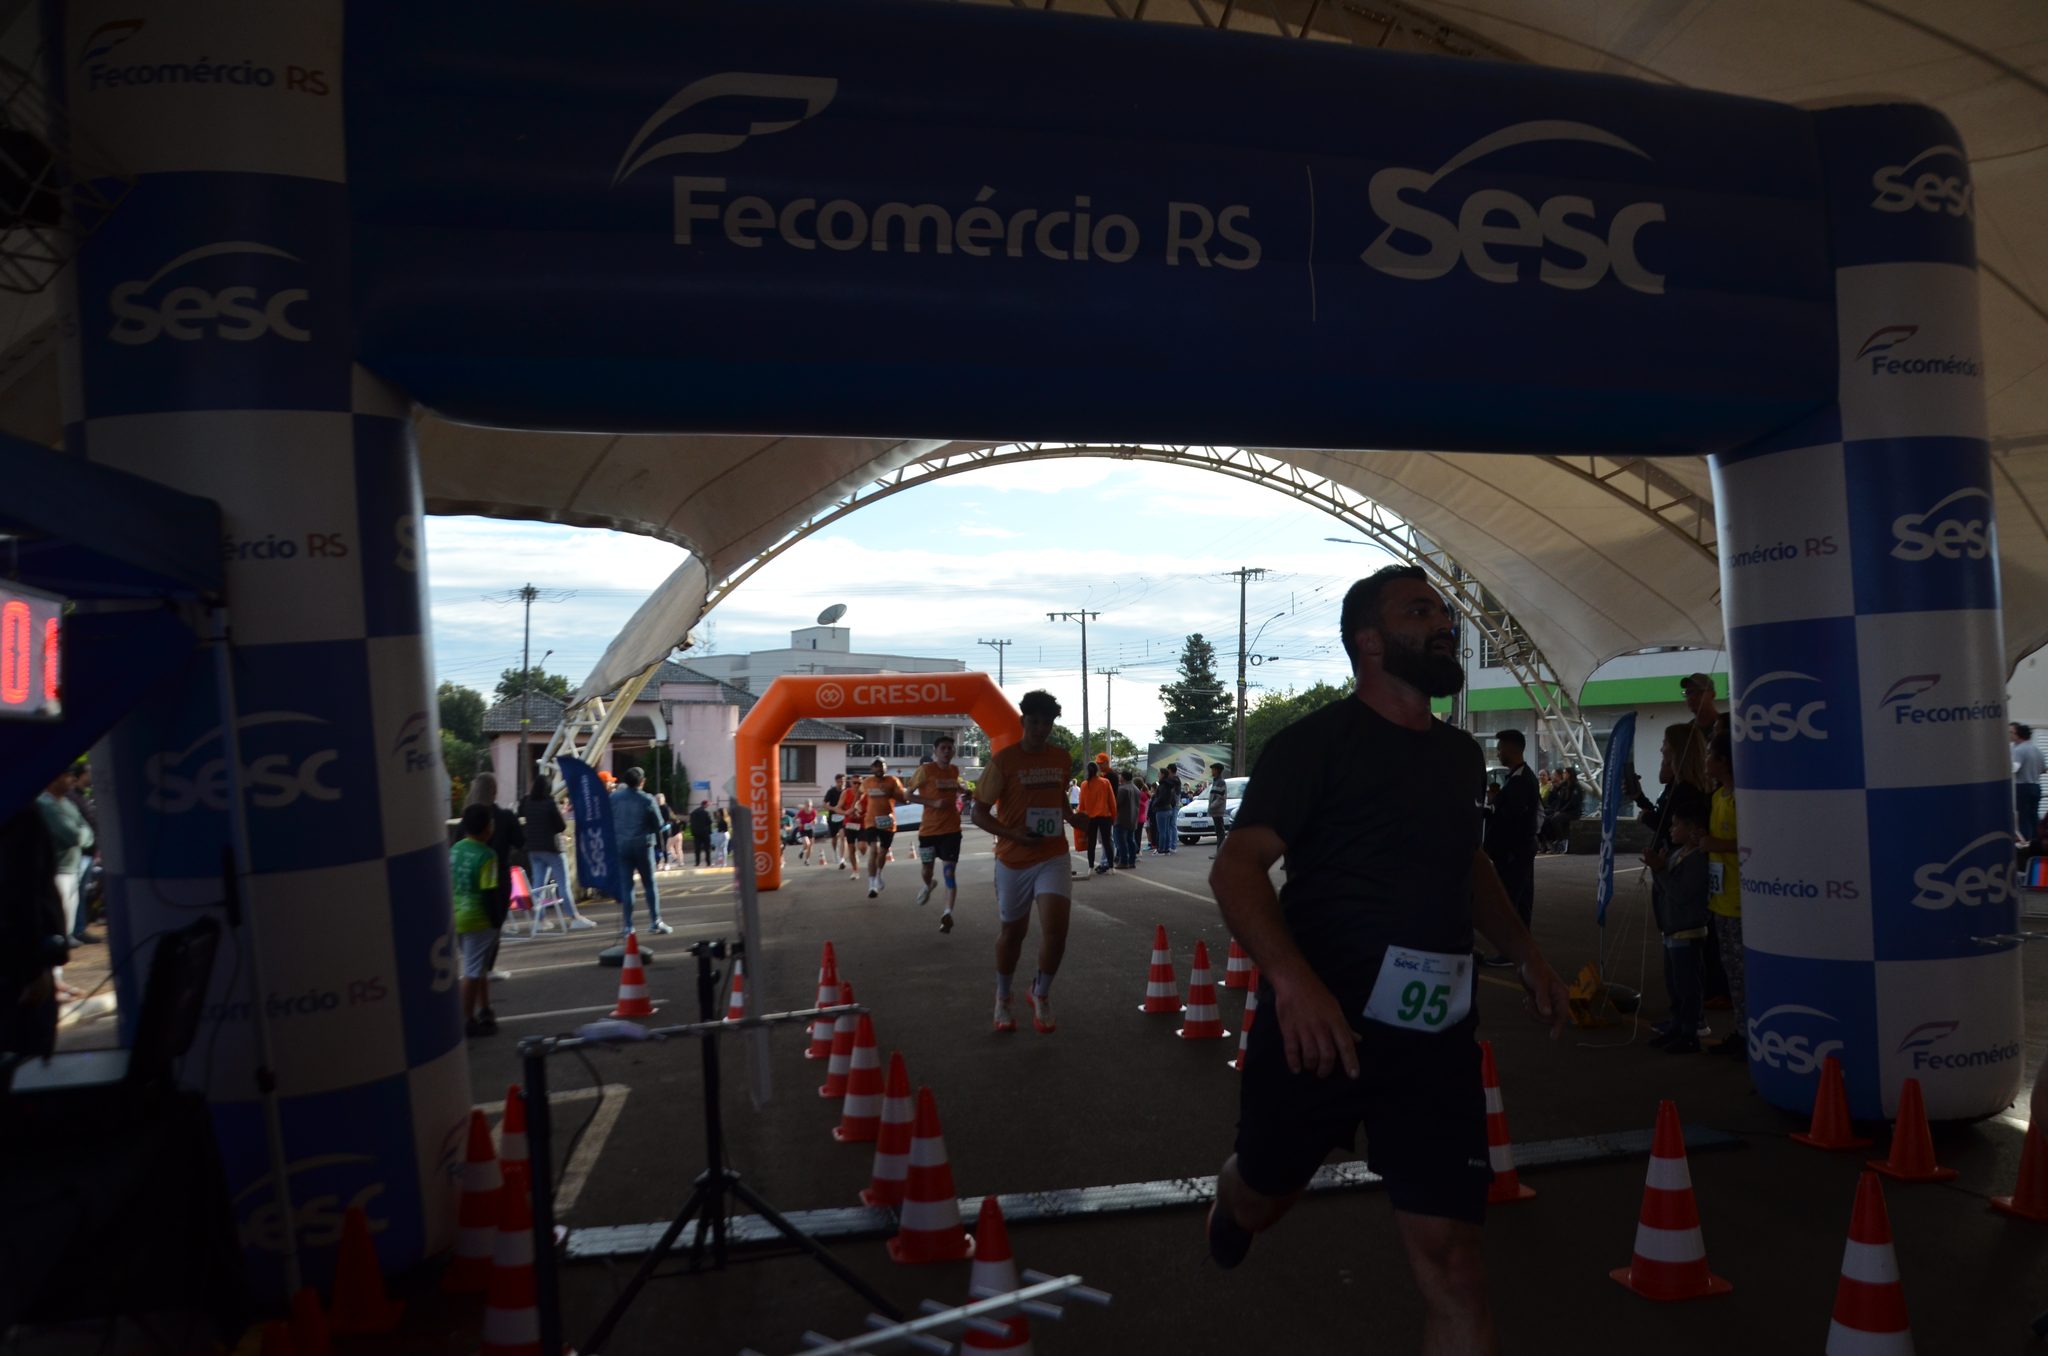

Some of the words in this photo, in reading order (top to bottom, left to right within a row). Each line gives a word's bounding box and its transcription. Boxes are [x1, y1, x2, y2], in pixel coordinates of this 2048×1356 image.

[88, 55, 275, 92] Fecomércio
[286, 65, 330, 96] RS
[672, 174, 1141, 264] Fecomércio
[1165, 201, 1263, 270] RS
[1360, 166, 1666, 295] Sesc
[307, 532, 348, 559] RS
[1805, 535, 1839, 557] RS
[852, 683, 956, 705] CRESOL
[1895, 701, 2002, 724] Fecomércio
[750, 757, 769, 846] CRESOL
[1036, 818, 1056, 834] 80
[1740, 878, 1818, 898] ecomércio
[1826, 880, 1859, 900] RS
[347, 976, 387, 1007] RS
[1397, 980, 1451, 1025] 95
[1913, 1042, 2020, 1070] Fecomércio
[236, 1181, 391, 1250] esc
